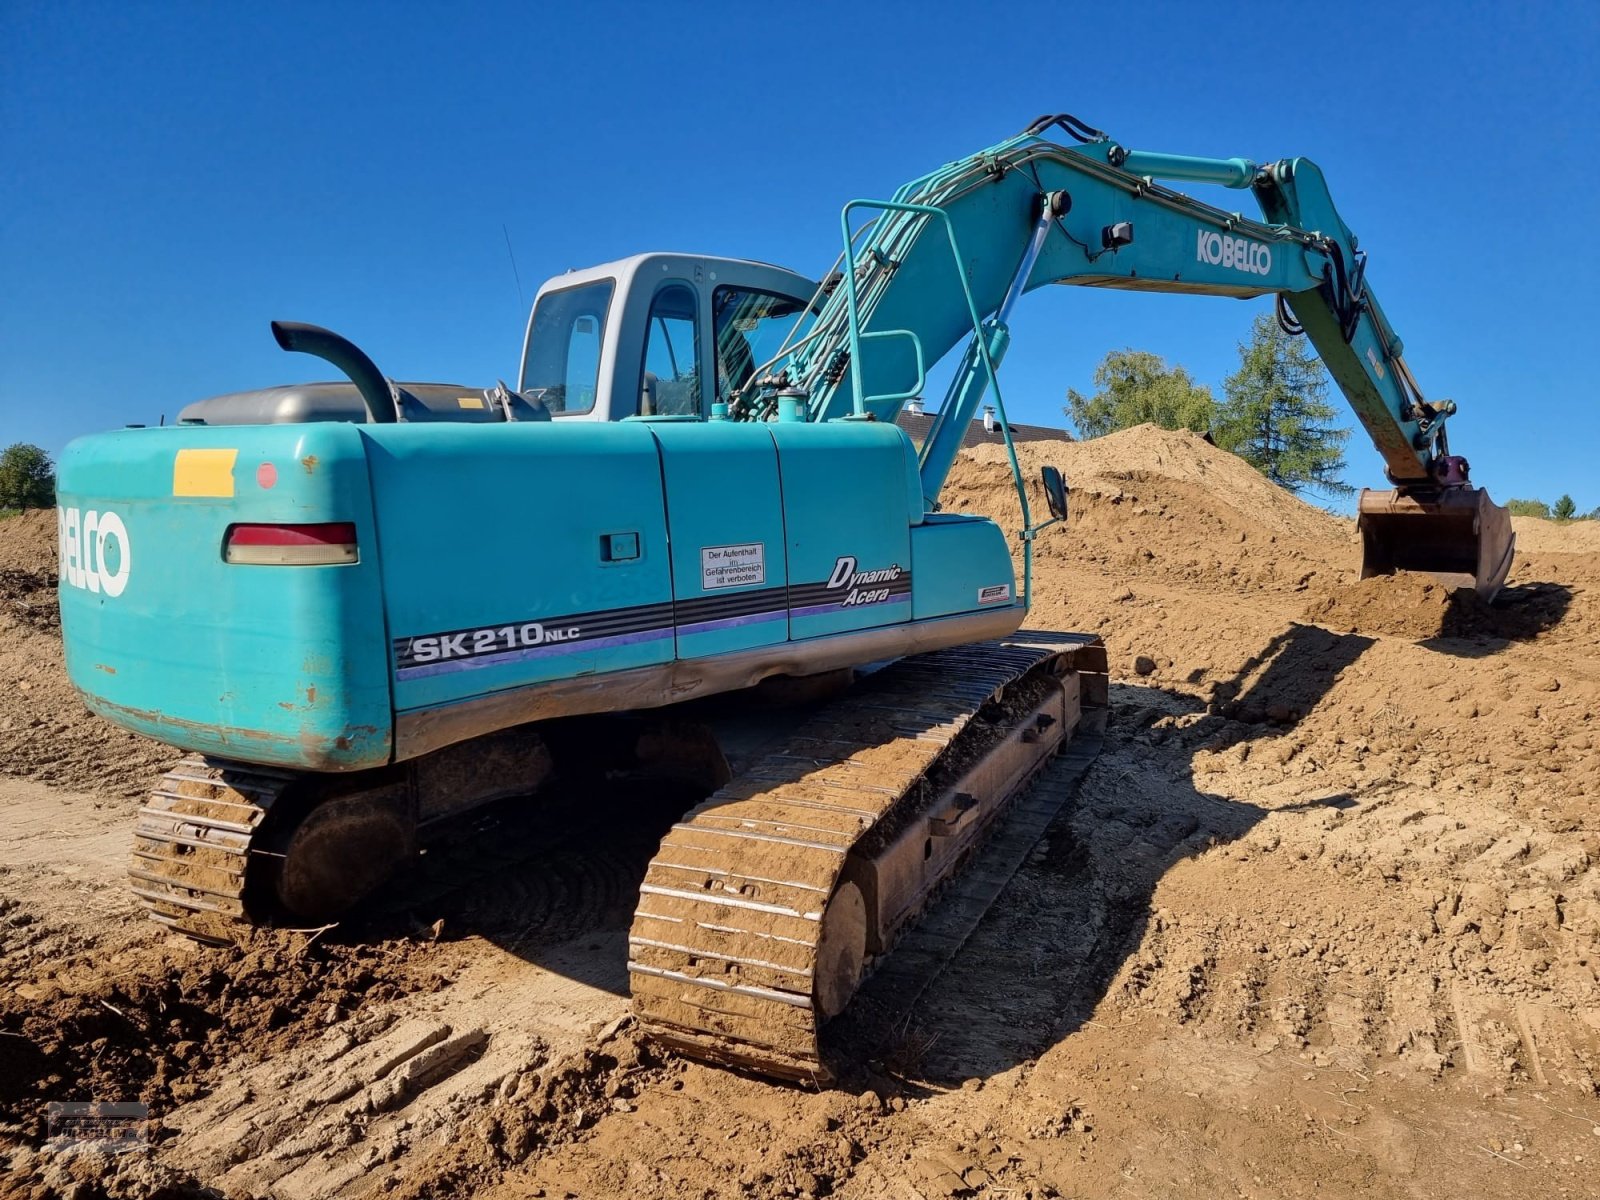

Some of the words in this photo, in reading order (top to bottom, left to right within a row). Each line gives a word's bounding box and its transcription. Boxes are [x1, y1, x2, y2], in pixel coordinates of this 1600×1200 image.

[1197, 229, 1271, 276] KOBELCO
[708, 551, 721, 559] Der
[723, 548, 757, 558] Aufenthalt
[705, 564, 762, 576] Gefahrenbereich
[826, 556, 902, 590] Dynamic
[716, 576, 725, 584] ist
[727, 574, 757, 583] verboten
[842, 588, 890, 606] Acera
